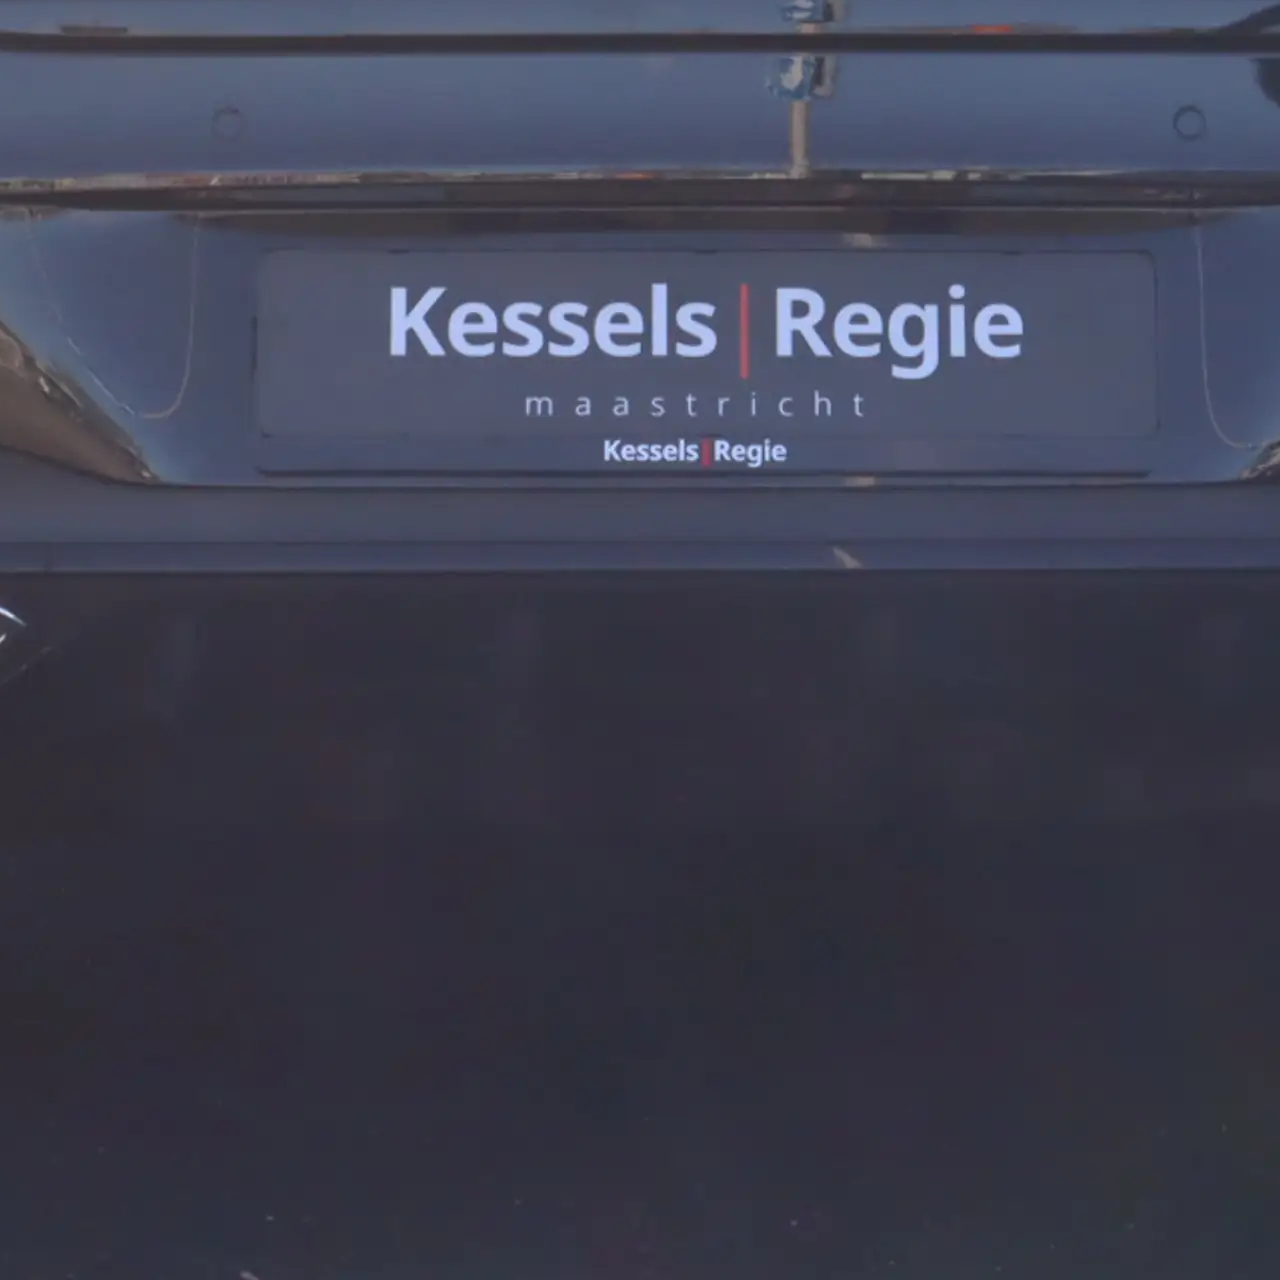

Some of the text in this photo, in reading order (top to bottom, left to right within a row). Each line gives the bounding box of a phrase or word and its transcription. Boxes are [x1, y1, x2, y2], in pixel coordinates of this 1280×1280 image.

[388, 282, 1025, 381] Kessels Regie
[524, 390, 866, 418] maastricht
[603, 438, 788, 468] Kessels Regie
